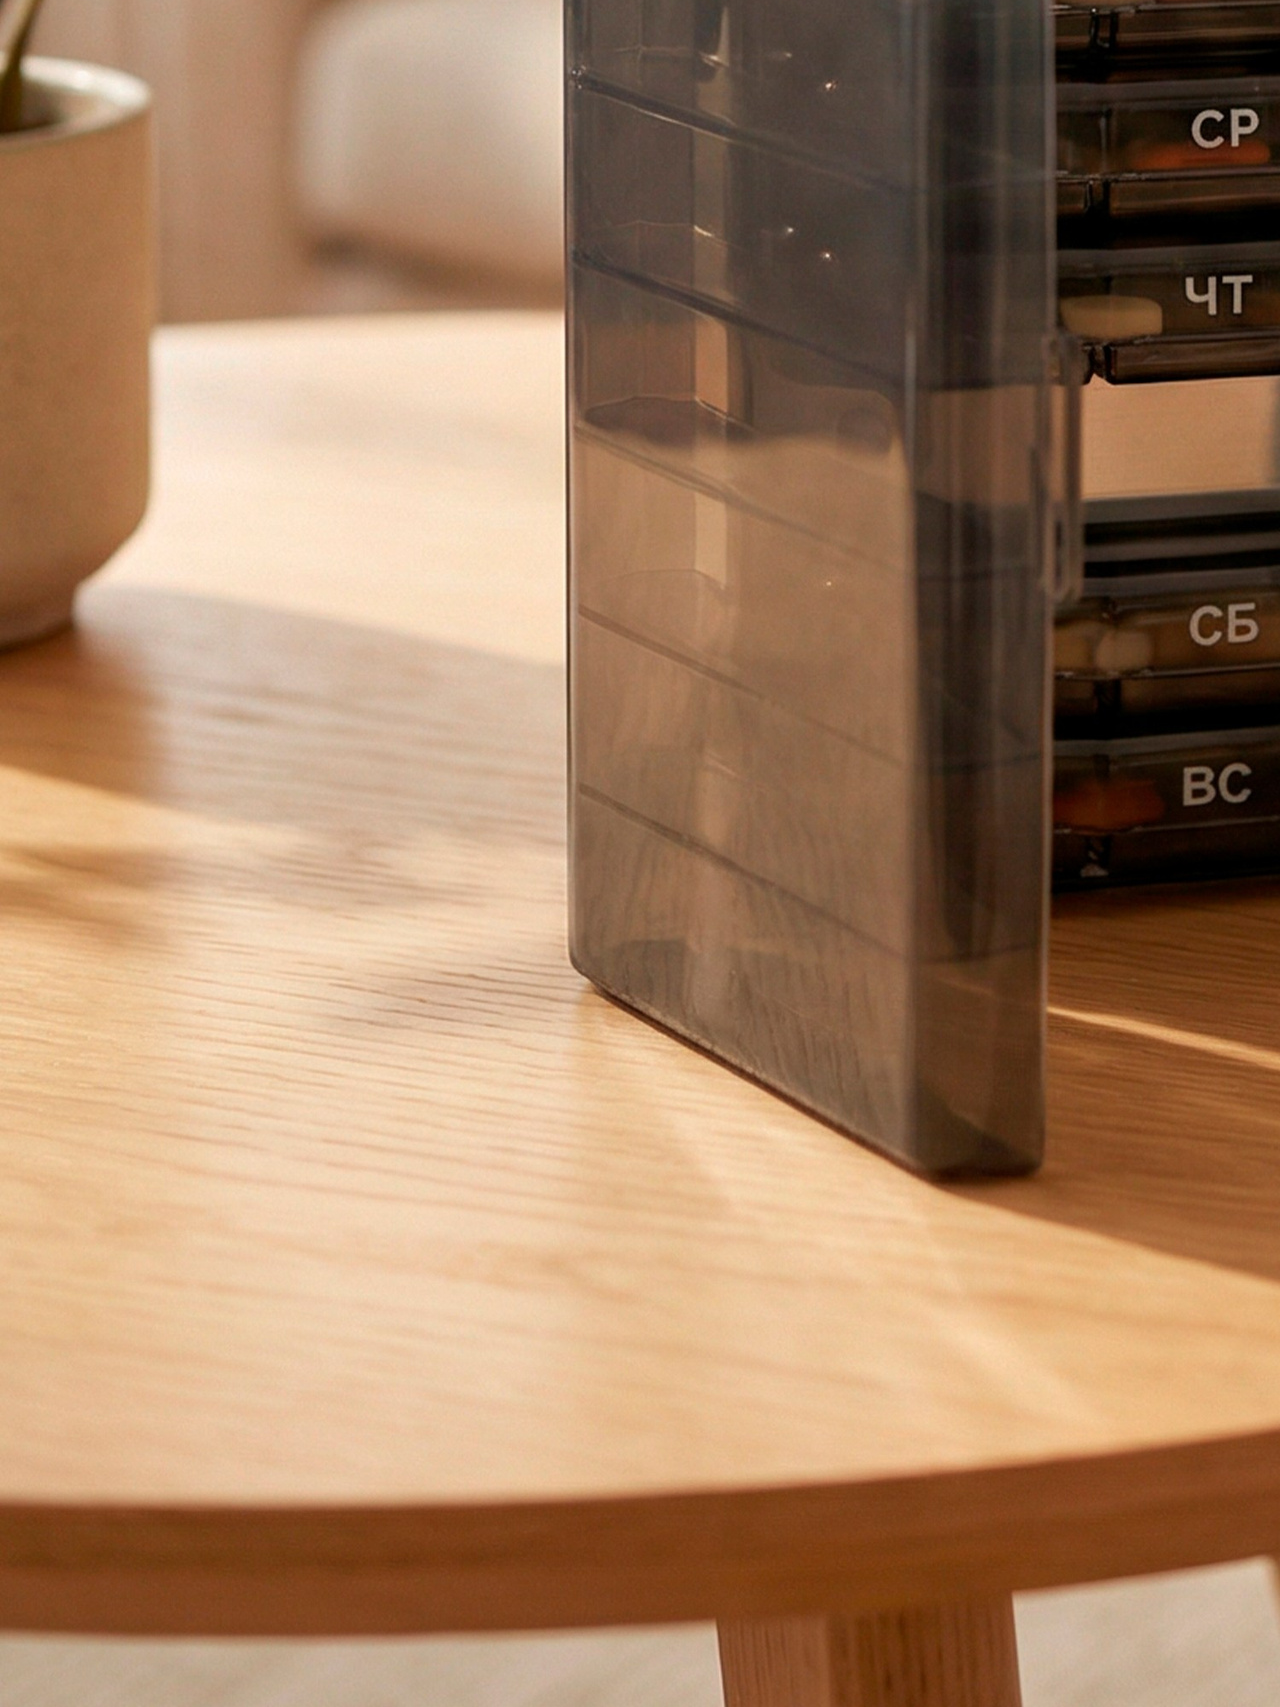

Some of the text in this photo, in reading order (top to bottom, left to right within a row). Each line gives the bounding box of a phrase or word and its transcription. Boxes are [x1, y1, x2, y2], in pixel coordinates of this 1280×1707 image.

[1191, 109, 1259, 148] СР
[1185, 276, 1252, 314] ЧТ
[1190, 603, 1258, 646] СБ
[1183, 764, 1251, 805] ВС
